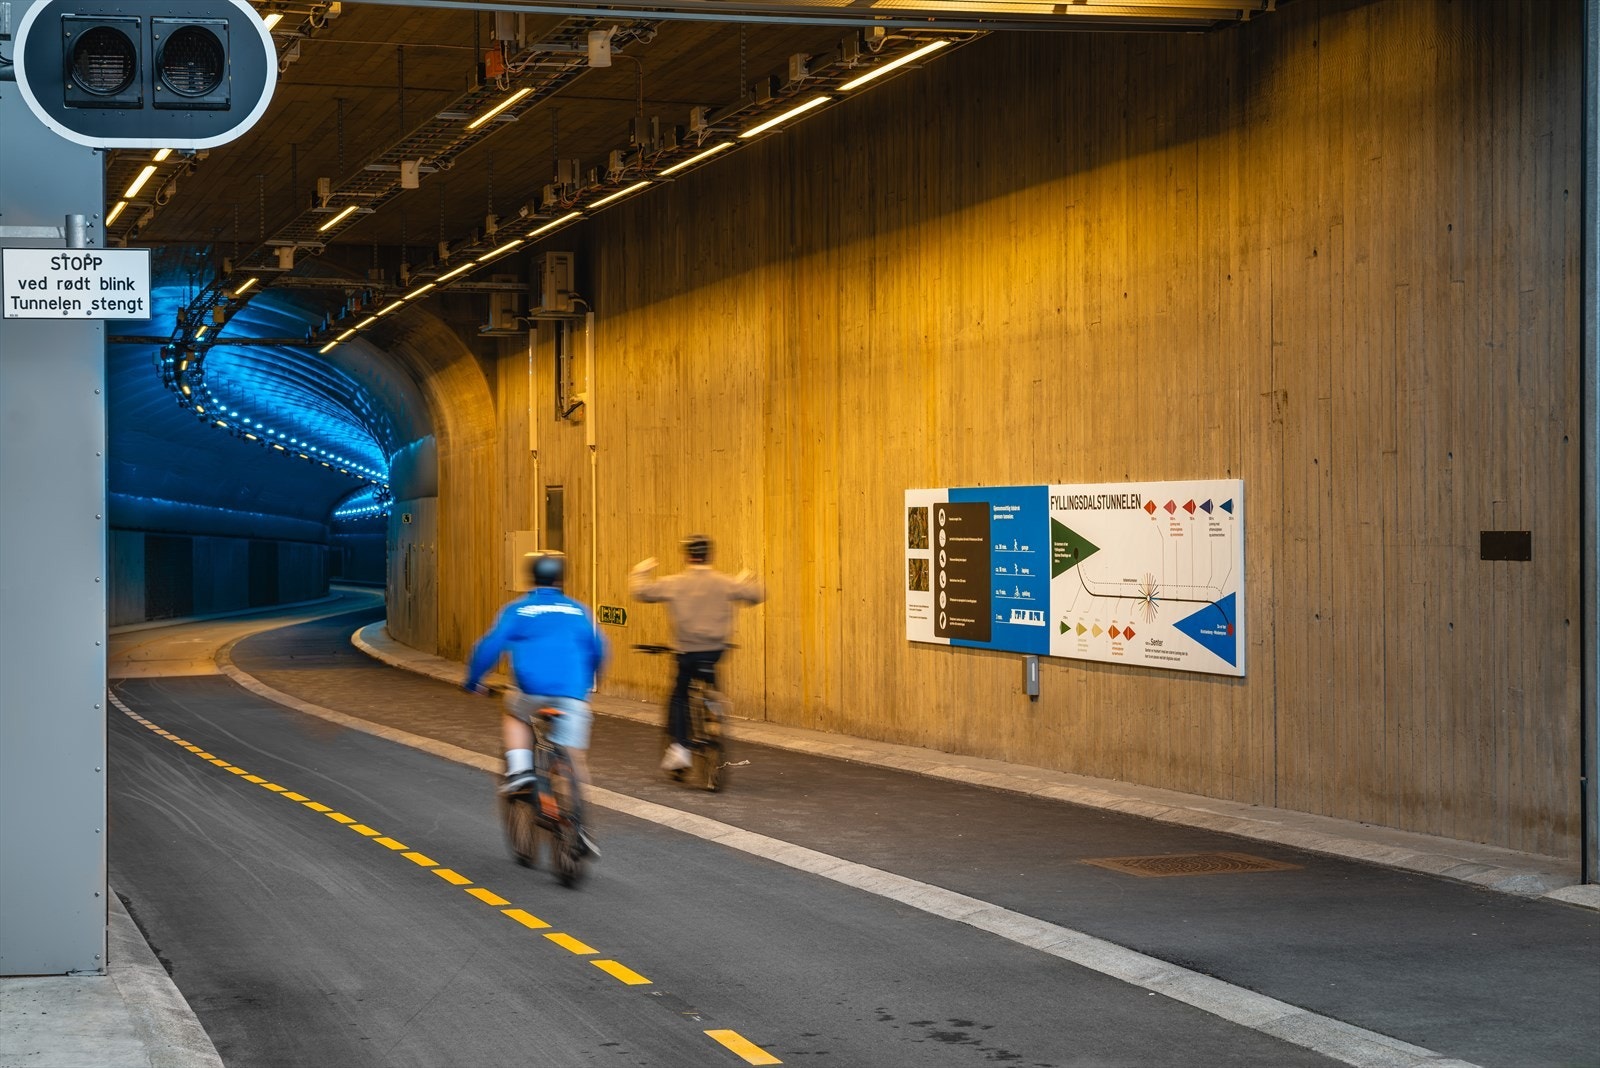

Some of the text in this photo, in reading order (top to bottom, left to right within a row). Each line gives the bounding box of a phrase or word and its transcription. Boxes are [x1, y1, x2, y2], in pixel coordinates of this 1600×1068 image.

[51, 256, 103, 271] STOPP
[18, 276, 136, 291] ved rødt blink
[10, 296, 143, 313] Tunnelen stengt
[1050, 494, 1141, 510] FYLLINGSDALSTUNNELEN
